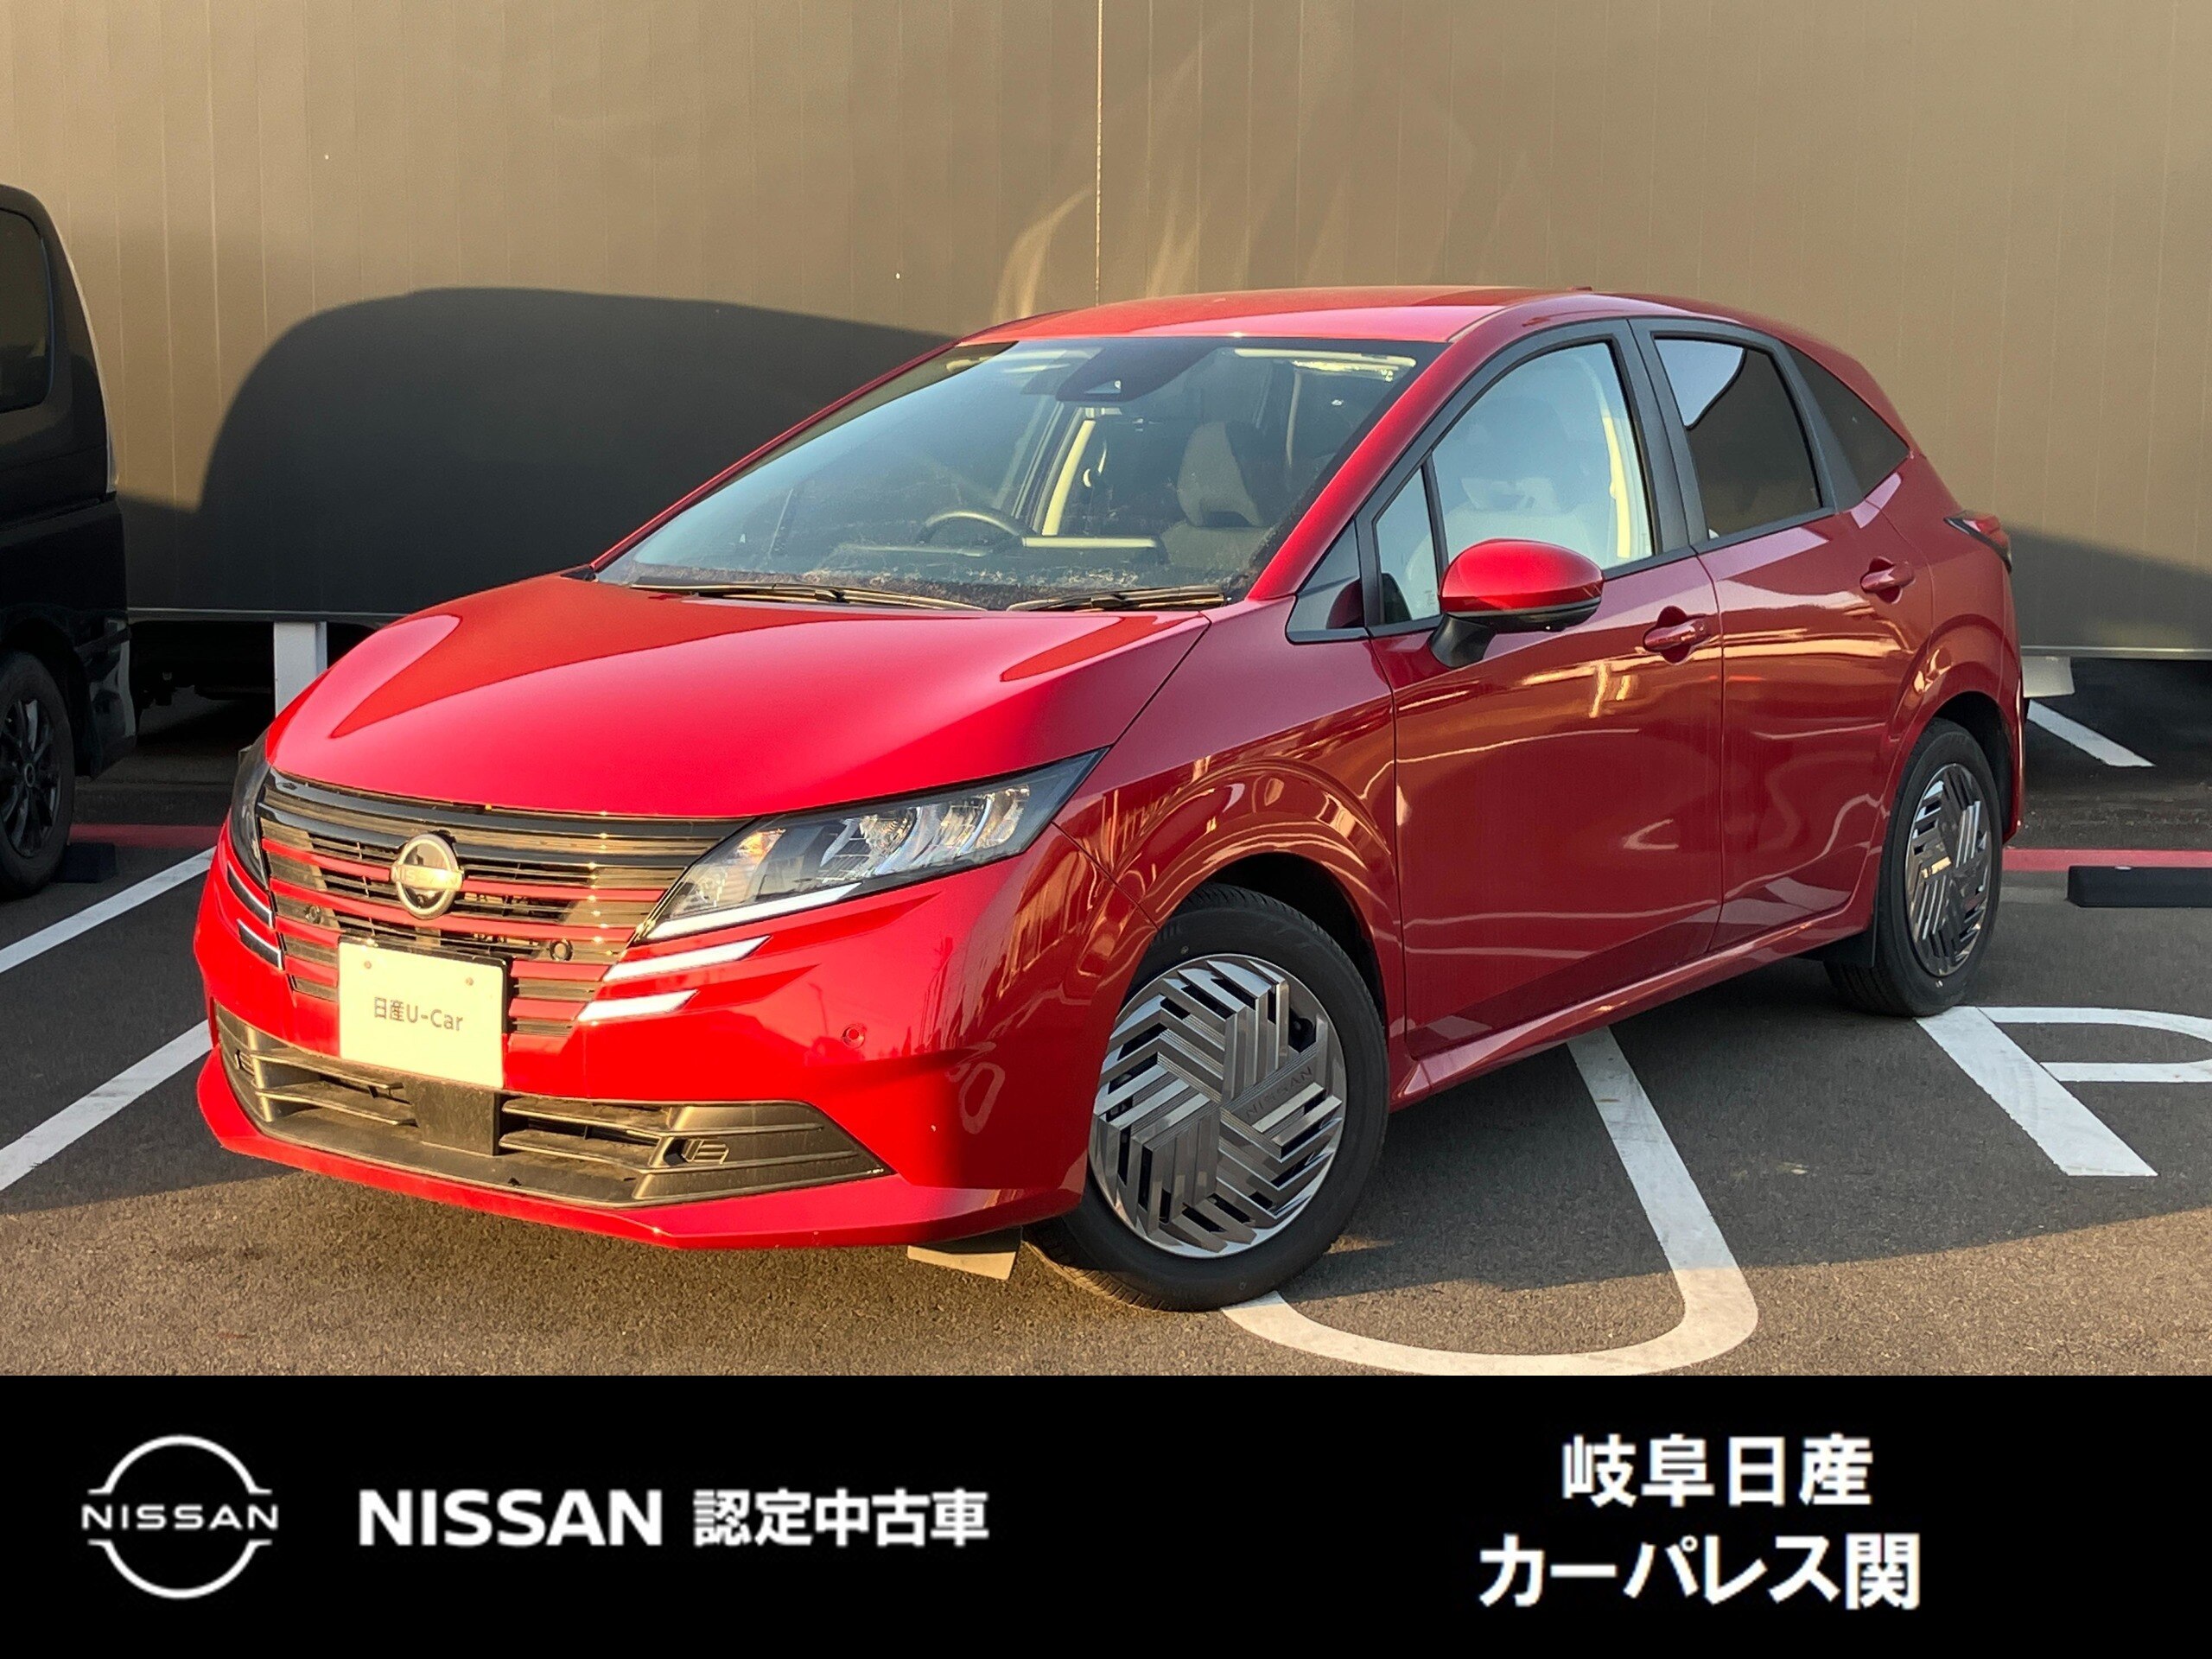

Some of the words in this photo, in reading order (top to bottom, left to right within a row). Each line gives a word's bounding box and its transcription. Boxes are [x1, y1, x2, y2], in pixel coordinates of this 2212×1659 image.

[391, 865, 461, 887] NISSN
[374, 996, 463, 1032] 日産U-Car
[1245, 1065, 1313, 1118] NISSAN
